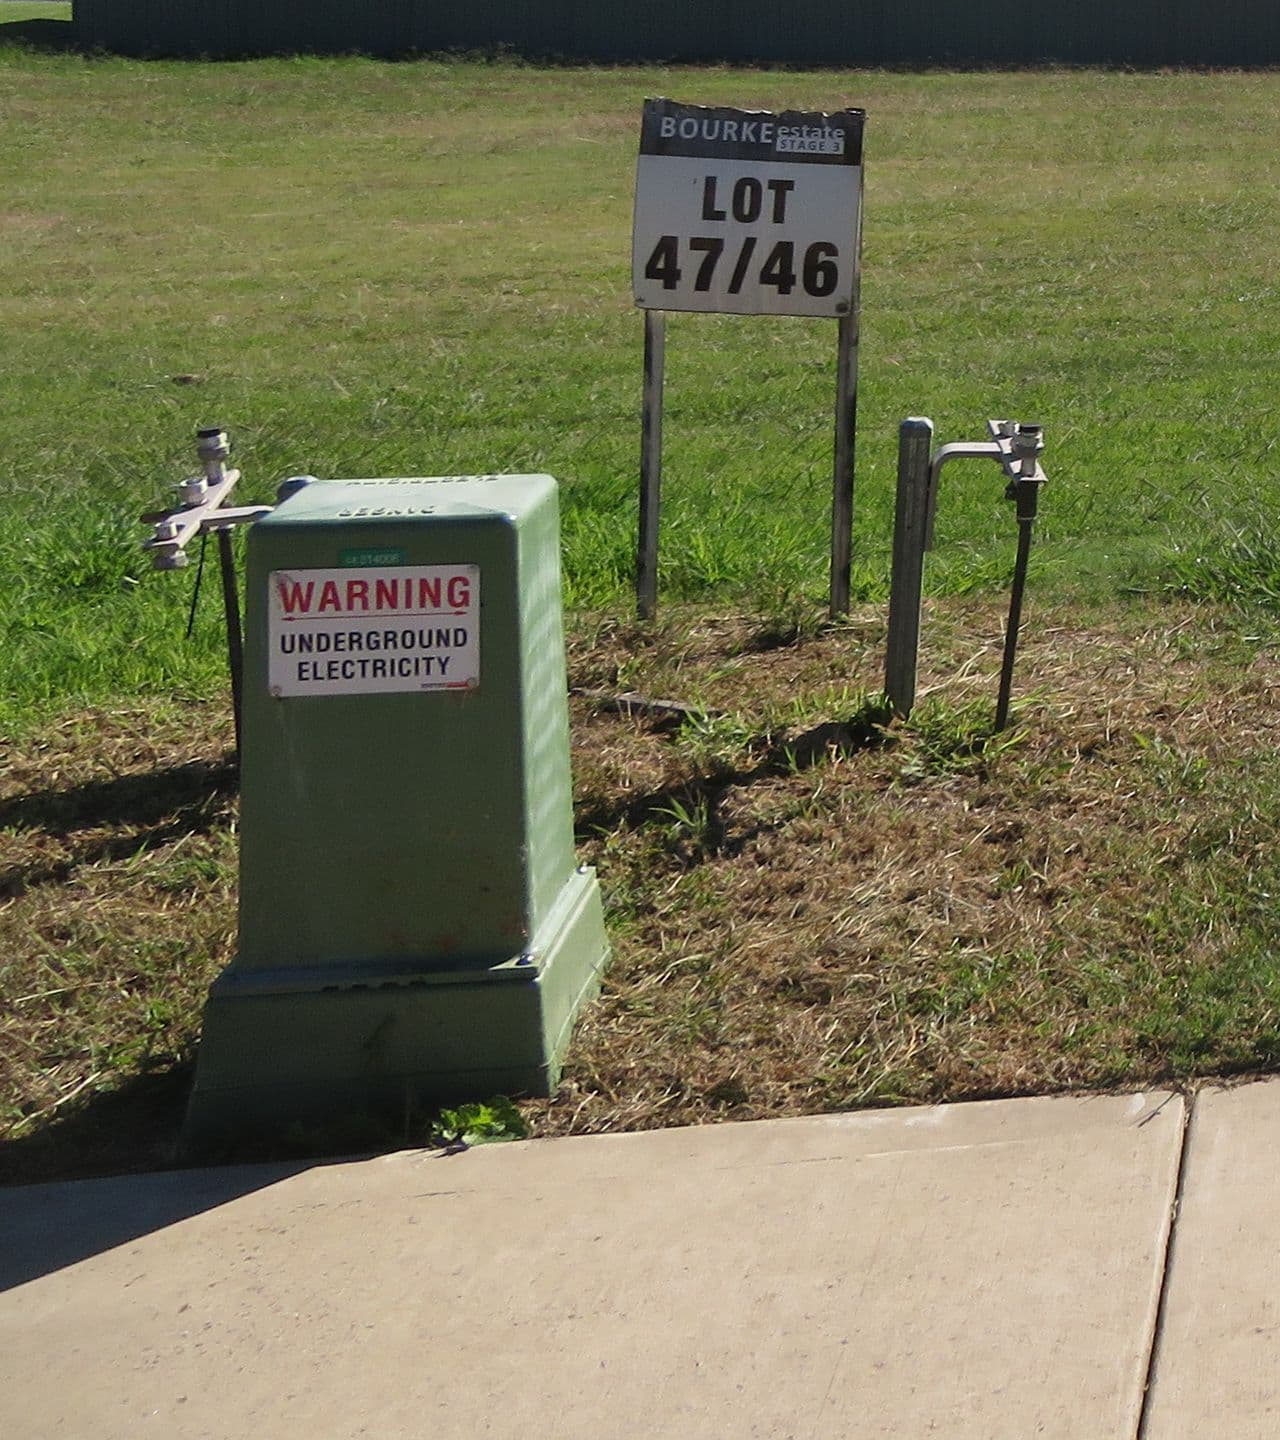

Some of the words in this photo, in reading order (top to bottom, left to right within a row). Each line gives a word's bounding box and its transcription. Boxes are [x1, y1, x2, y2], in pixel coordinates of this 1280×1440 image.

[660, 116, 774, 144] BOURKE
[776, 123, 845, 140] estate
[780, 139, 825, 151] STAGE
[831, 141, 841, 152] 3
[702, 176, 795, 224] LOT
[645, 235, 839, 297] 47/46
[279, 576, 470, 614] WARNING
[280, 627, 468, 654] UNDERGROUND
[297, 656, 451, 681] ELECTRICITY
